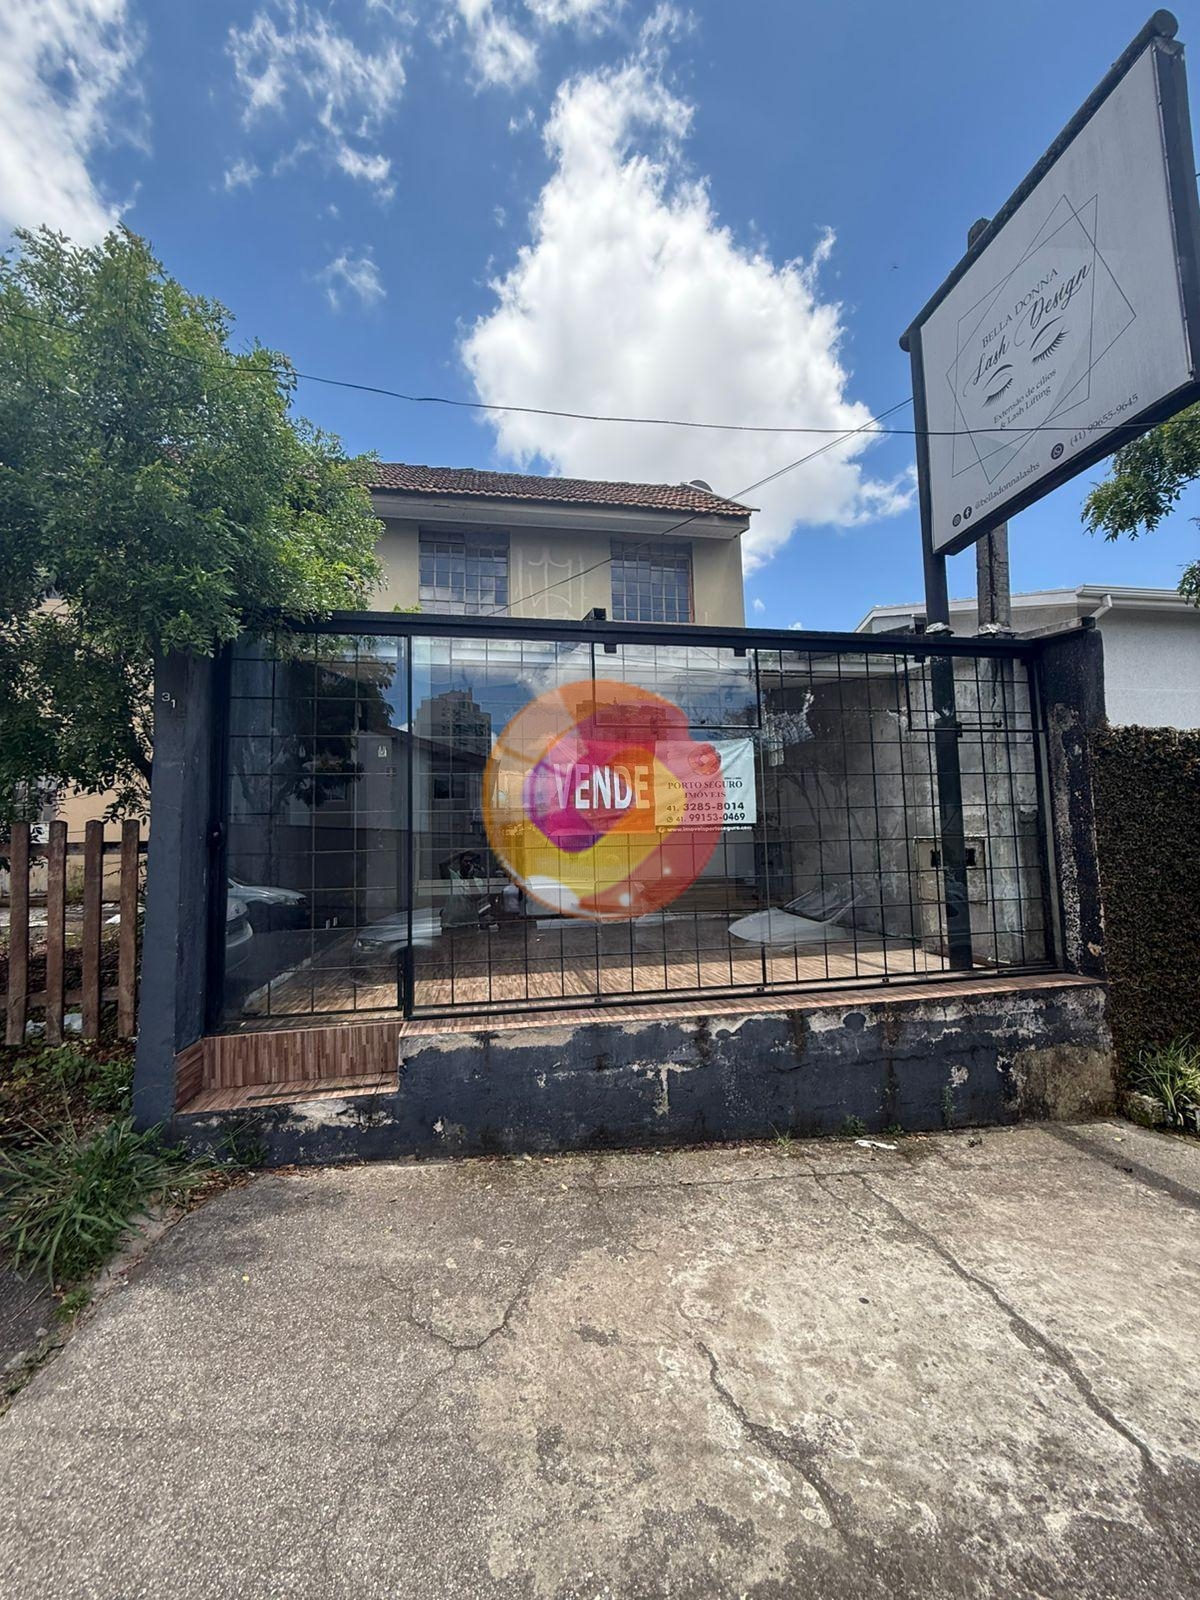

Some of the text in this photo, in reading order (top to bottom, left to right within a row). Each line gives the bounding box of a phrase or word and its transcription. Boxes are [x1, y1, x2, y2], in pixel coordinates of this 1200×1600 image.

[981, 268, 1059, 348] BELLA DONNA
[963, 262, 1093, 398] Lash Design
[1025, 387, 1036, 398] de
[1007, 406, 1025, 425] Lash
[1070, 429, 1087, 447] (41)
[553, 762, 652, 811] VENDE
[667, 780, 743, 790] PORTO SEGURO
[683, 802, 744, 811] 3285-8014
[688, 812, 746, 822] 99153-0469
